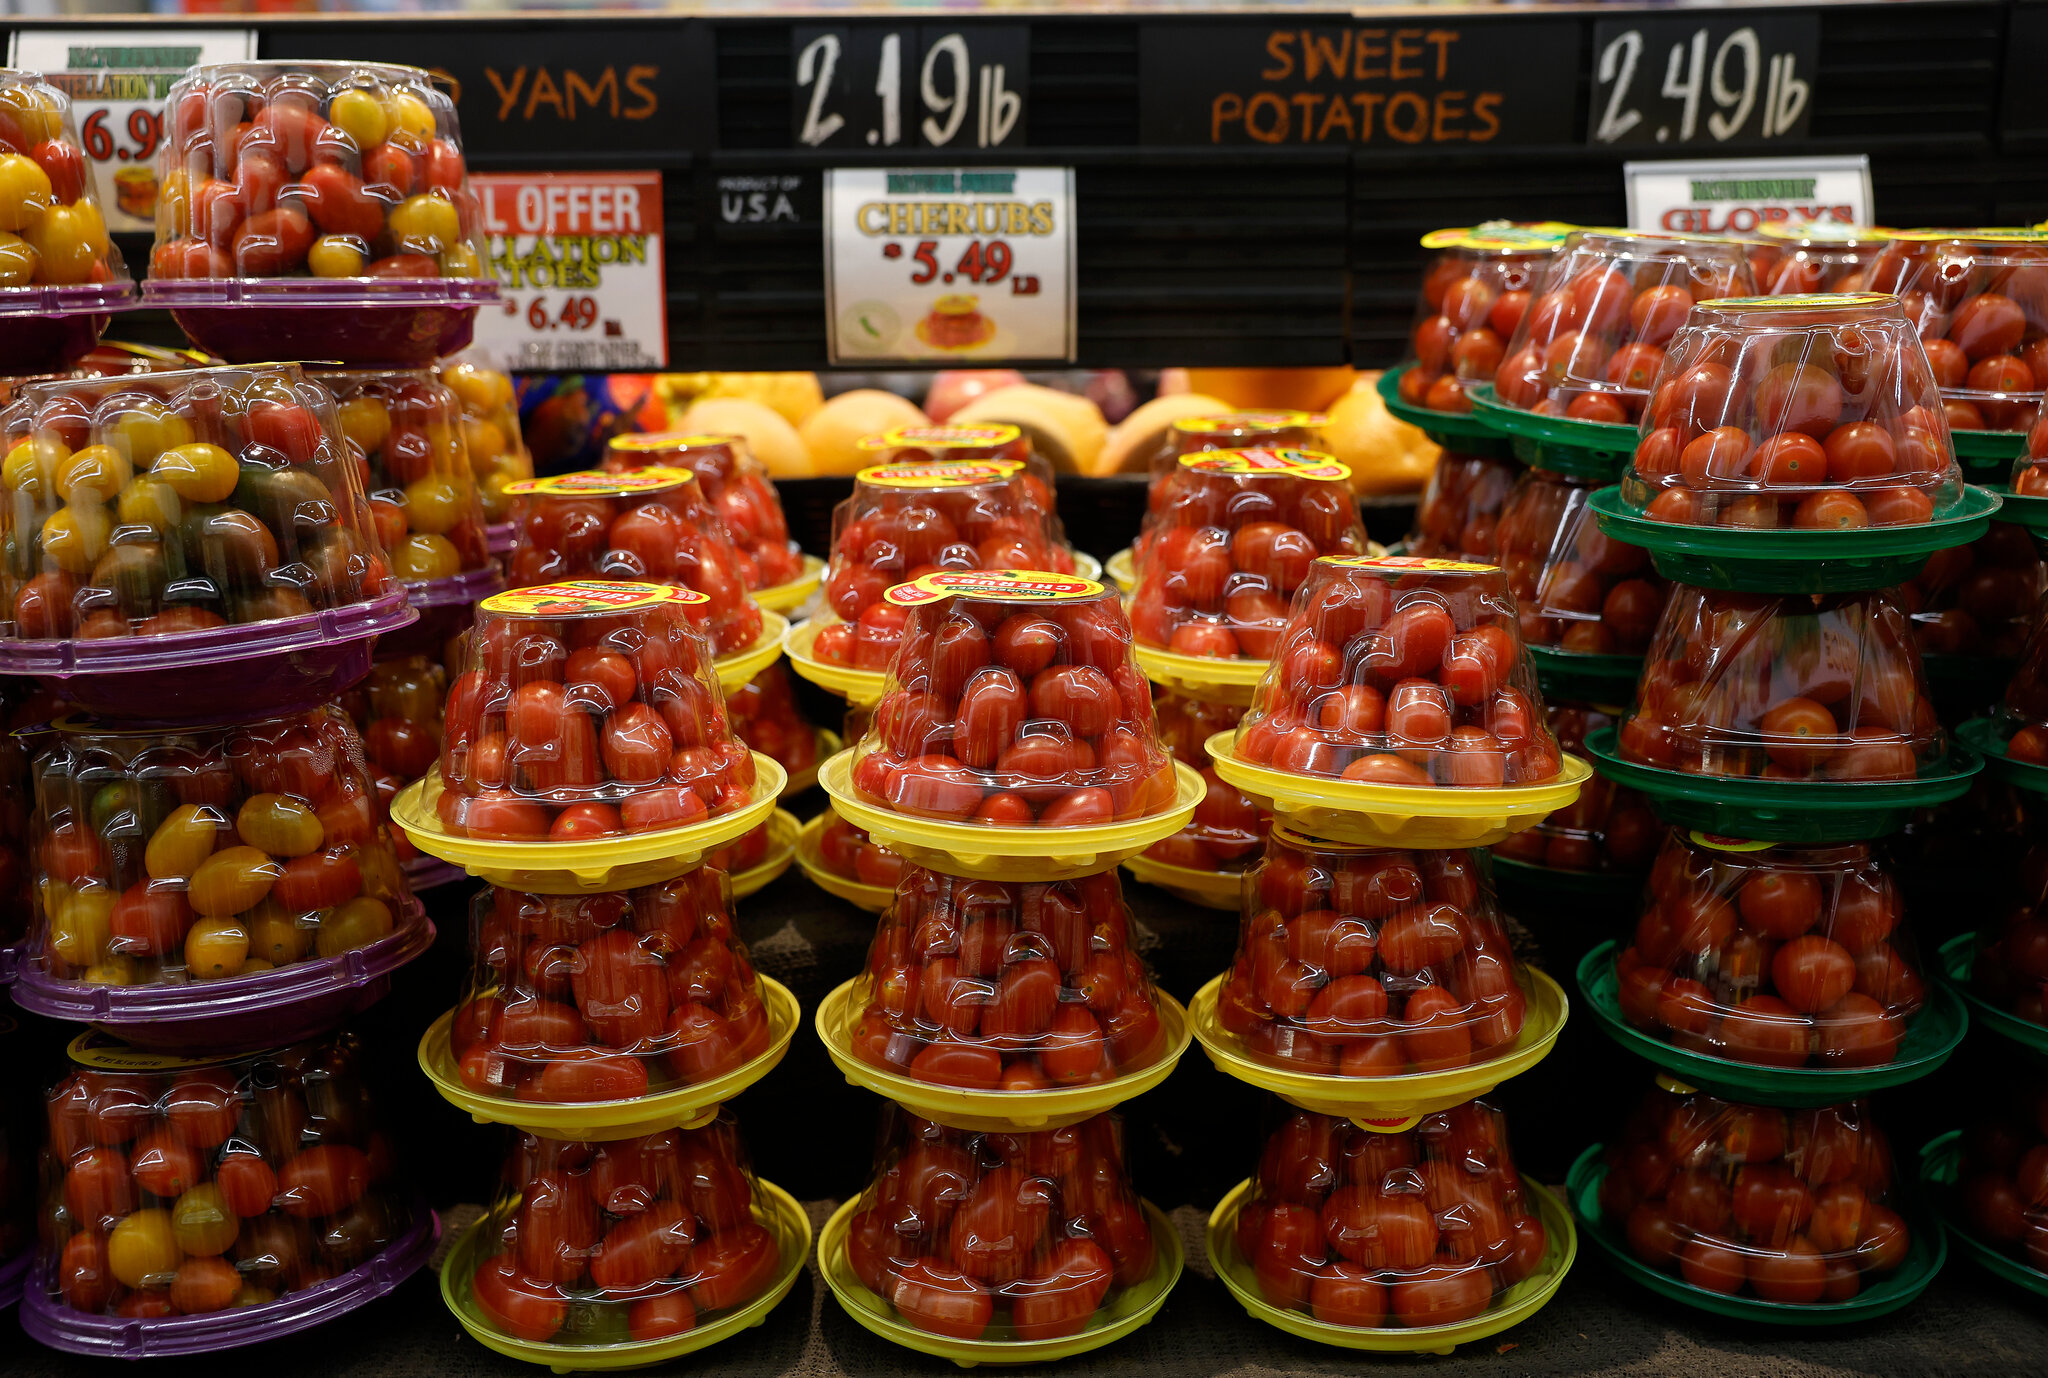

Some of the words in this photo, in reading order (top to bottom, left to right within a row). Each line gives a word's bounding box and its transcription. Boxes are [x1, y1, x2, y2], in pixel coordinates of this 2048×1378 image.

[1262, 30, 1460, 80] SWEET
[484, 65, 660, 121] YAMS
[83, 108, 164, 161] 6.9
[1212, 91, 1505, 144] POTATOES
[516, 186, 642, 231] OFFER
[857, 202, 1054, 236] CHERUBS
[527, 586, 641, 602] CHERUBS
[940, 576, 1073, 592] CHERUBS
